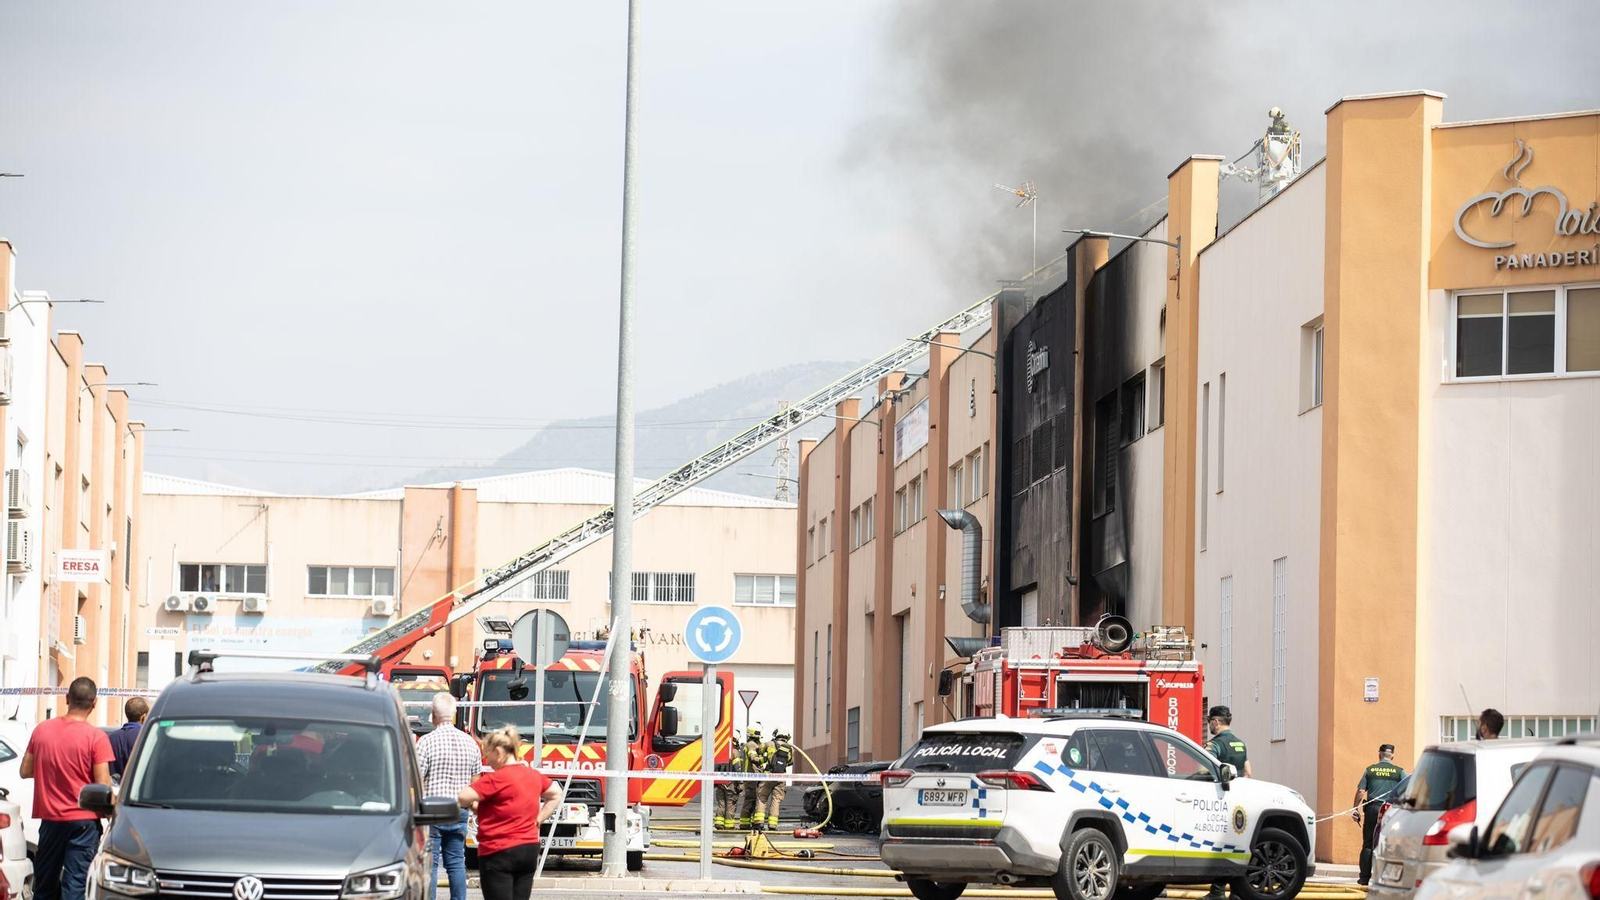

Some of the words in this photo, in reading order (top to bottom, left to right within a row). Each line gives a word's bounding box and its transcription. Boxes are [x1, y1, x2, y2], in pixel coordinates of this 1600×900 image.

[1494, 244, 1600, 269] PANADERÍ
[63, 561, 99, 571] ERESA
[913, 743, 963, 759] POLICÍA
[961, 745, 1007, 759] LOCAL
[923, 791, 945, 803] 6892
[947, 791, 964, 803] MFR
[1207, 813, 1228, 823] LOCAL
[1194, 823, 1229, 833] ALBOLOTE
[558, 838, 574, 847] LTY
